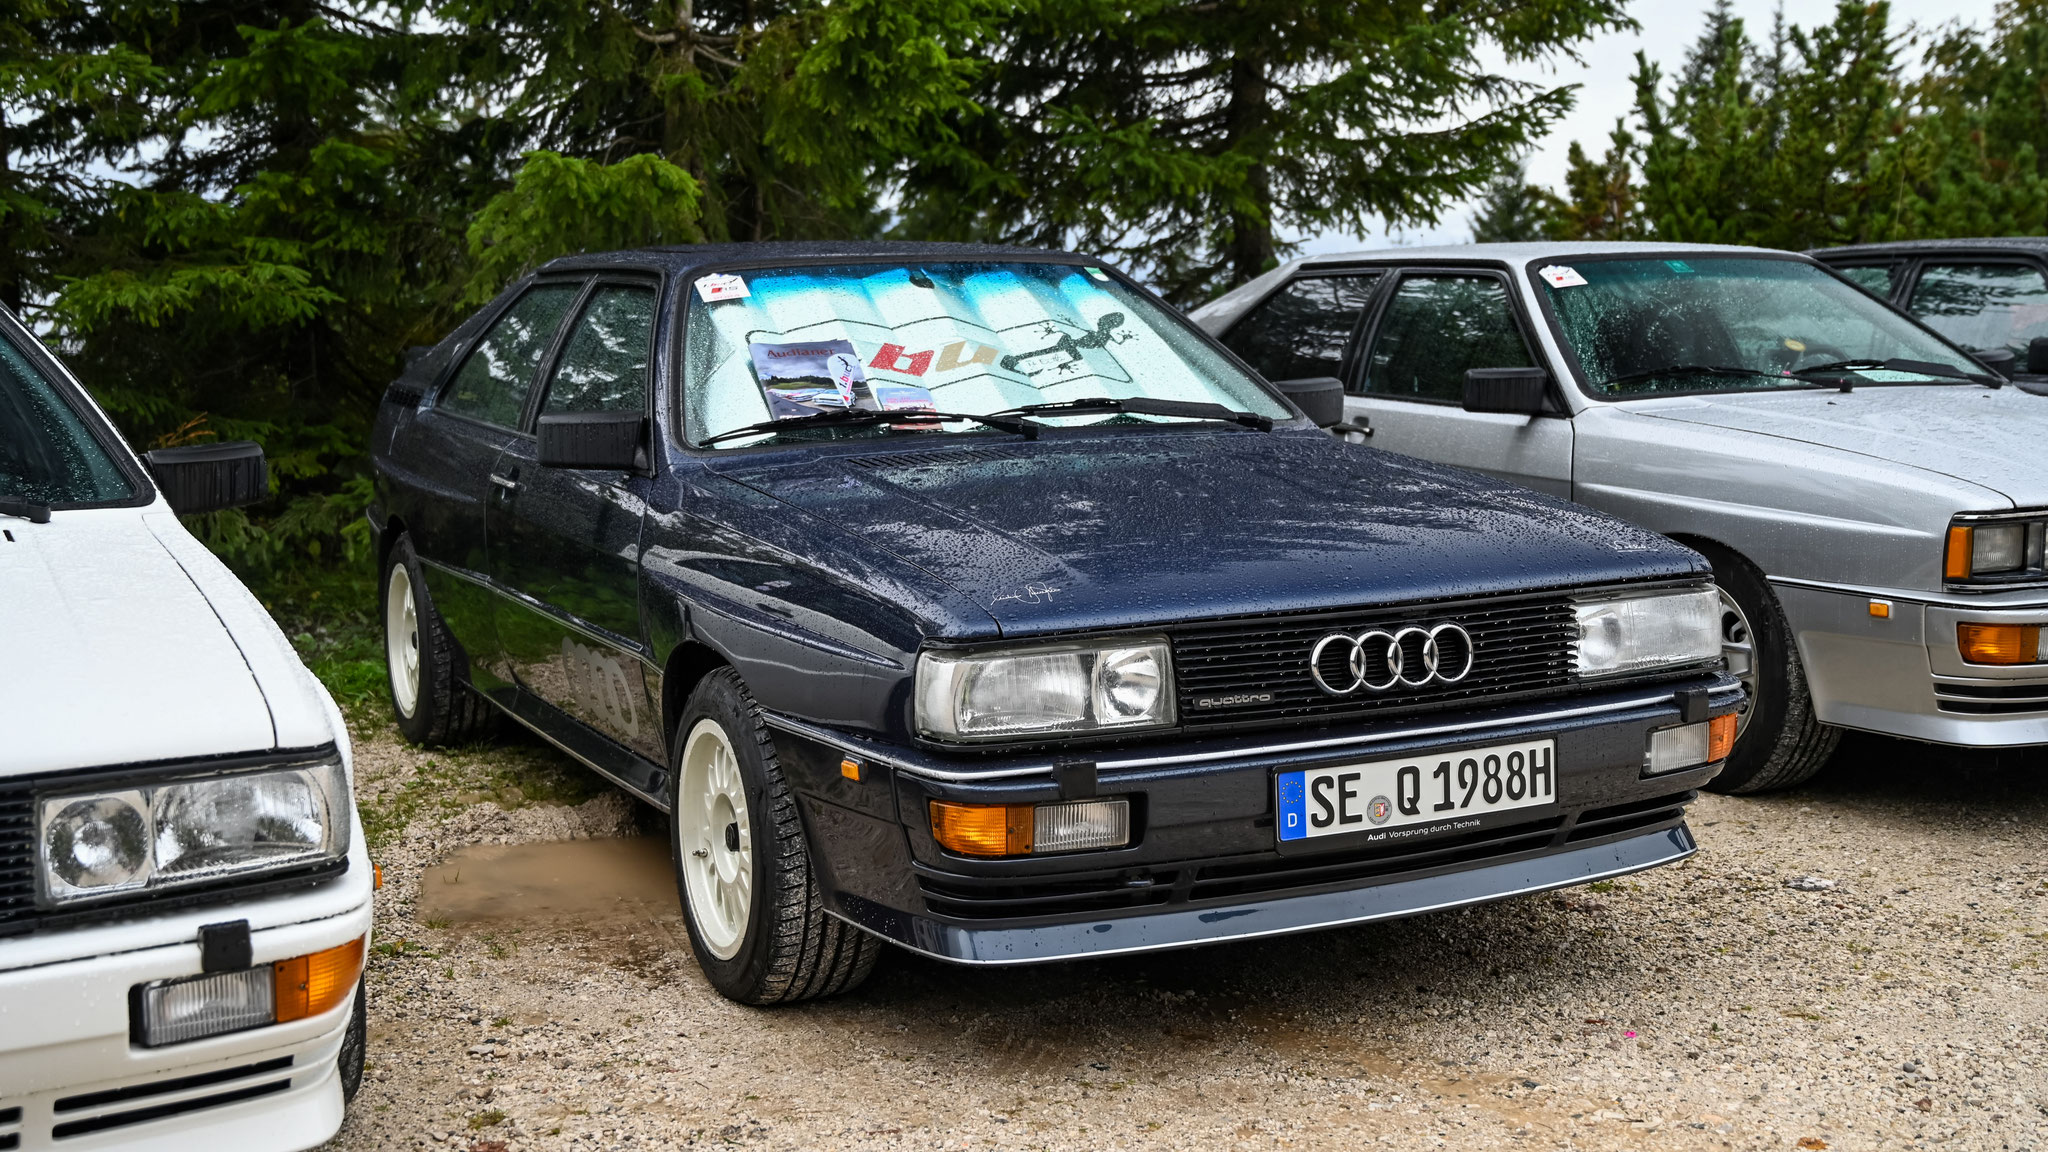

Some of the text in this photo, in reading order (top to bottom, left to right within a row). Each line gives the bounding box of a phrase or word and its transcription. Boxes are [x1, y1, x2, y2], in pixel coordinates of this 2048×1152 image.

[767, 347, 836, 359] Audianer
[1199, 694, 1271, 708] quattro
[1310, 772, 1363, 829] SE
[1396, 765, 1421, 816] Q
[1433, 746, 1552, 812] 1988H
[1287, 812, 1298, 828] D
[1367, 819, 1481, 842] Audi Vorsprung durch Technik
